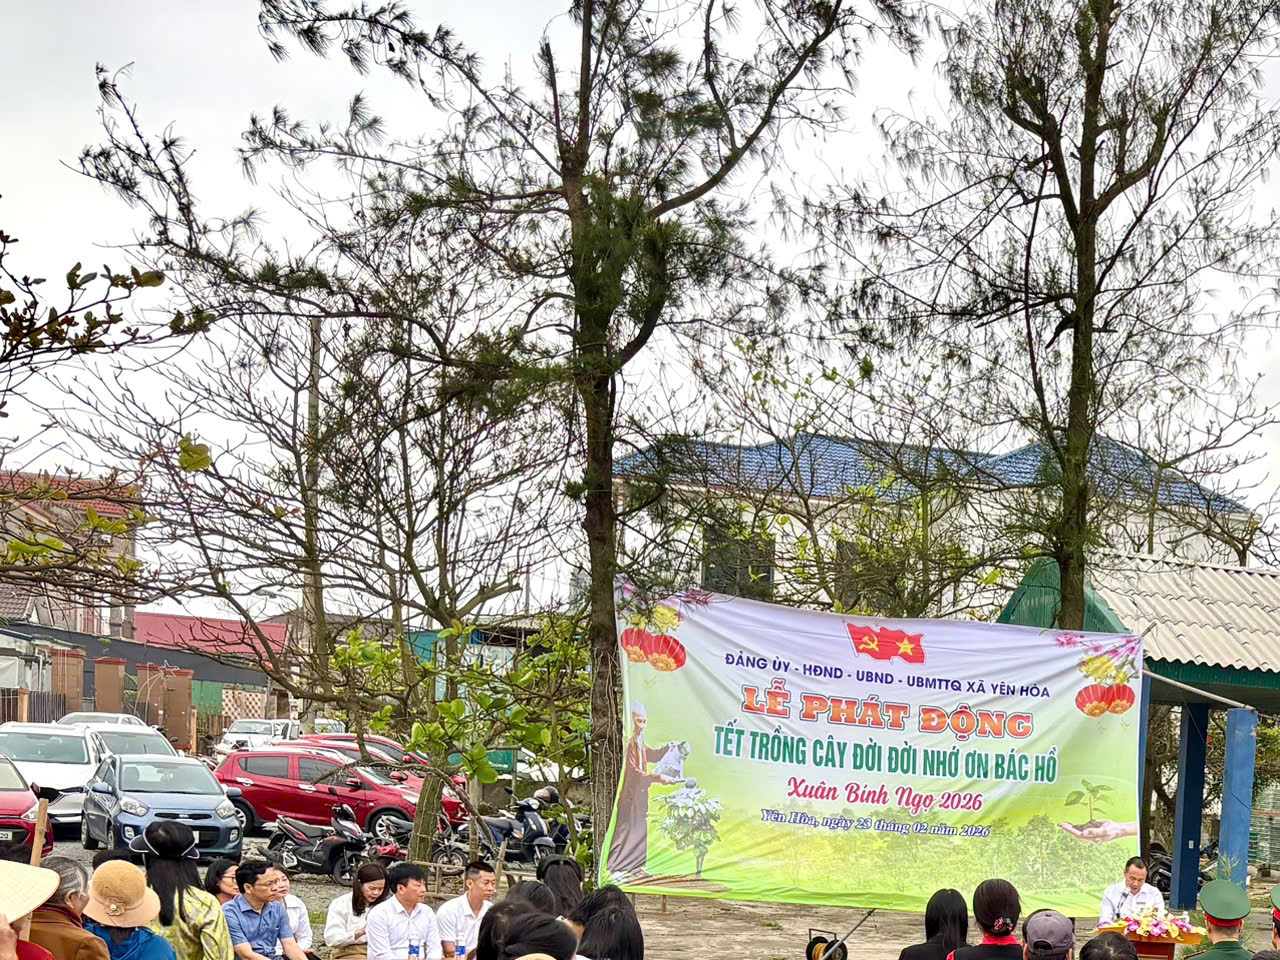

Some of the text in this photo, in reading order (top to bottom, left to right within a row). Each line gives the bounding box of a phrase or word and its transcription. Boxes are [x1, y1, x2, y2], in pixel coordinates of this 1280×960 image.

[725, 651, 768, 669] ĐẢNG
[803, 664, 843, 679] HĐND
[856, 670, 894, 684] UBND
[907, 675, 962, 692] UBMTTQ
[967, 680, 986, 694] XÃ
[991, 681, 1016, 696] YÊN
[1019, 684, 1050, 698] HÒA
[742, 678, 1032, 740] LỄ PHÁT ĐỘNG
[714, 719, 1057, 782] TẾT TRỒNG CÂY ĐỜI ĐỜI NHỚ ƠN BÁC HỒ
[787, 776, 983, 816] Xuân Bính Ngọ 2026
[761, 809, 786, 823] Yên
[790, 811, 819, 828] Hòa,
[822, 815, 854, 830] ngày
[874, 819, 911, 835] tháng
[912, 822, 928, 833] 02
[930, 823, 958, 836] năm
[959, 824, 991, 837] 2026
